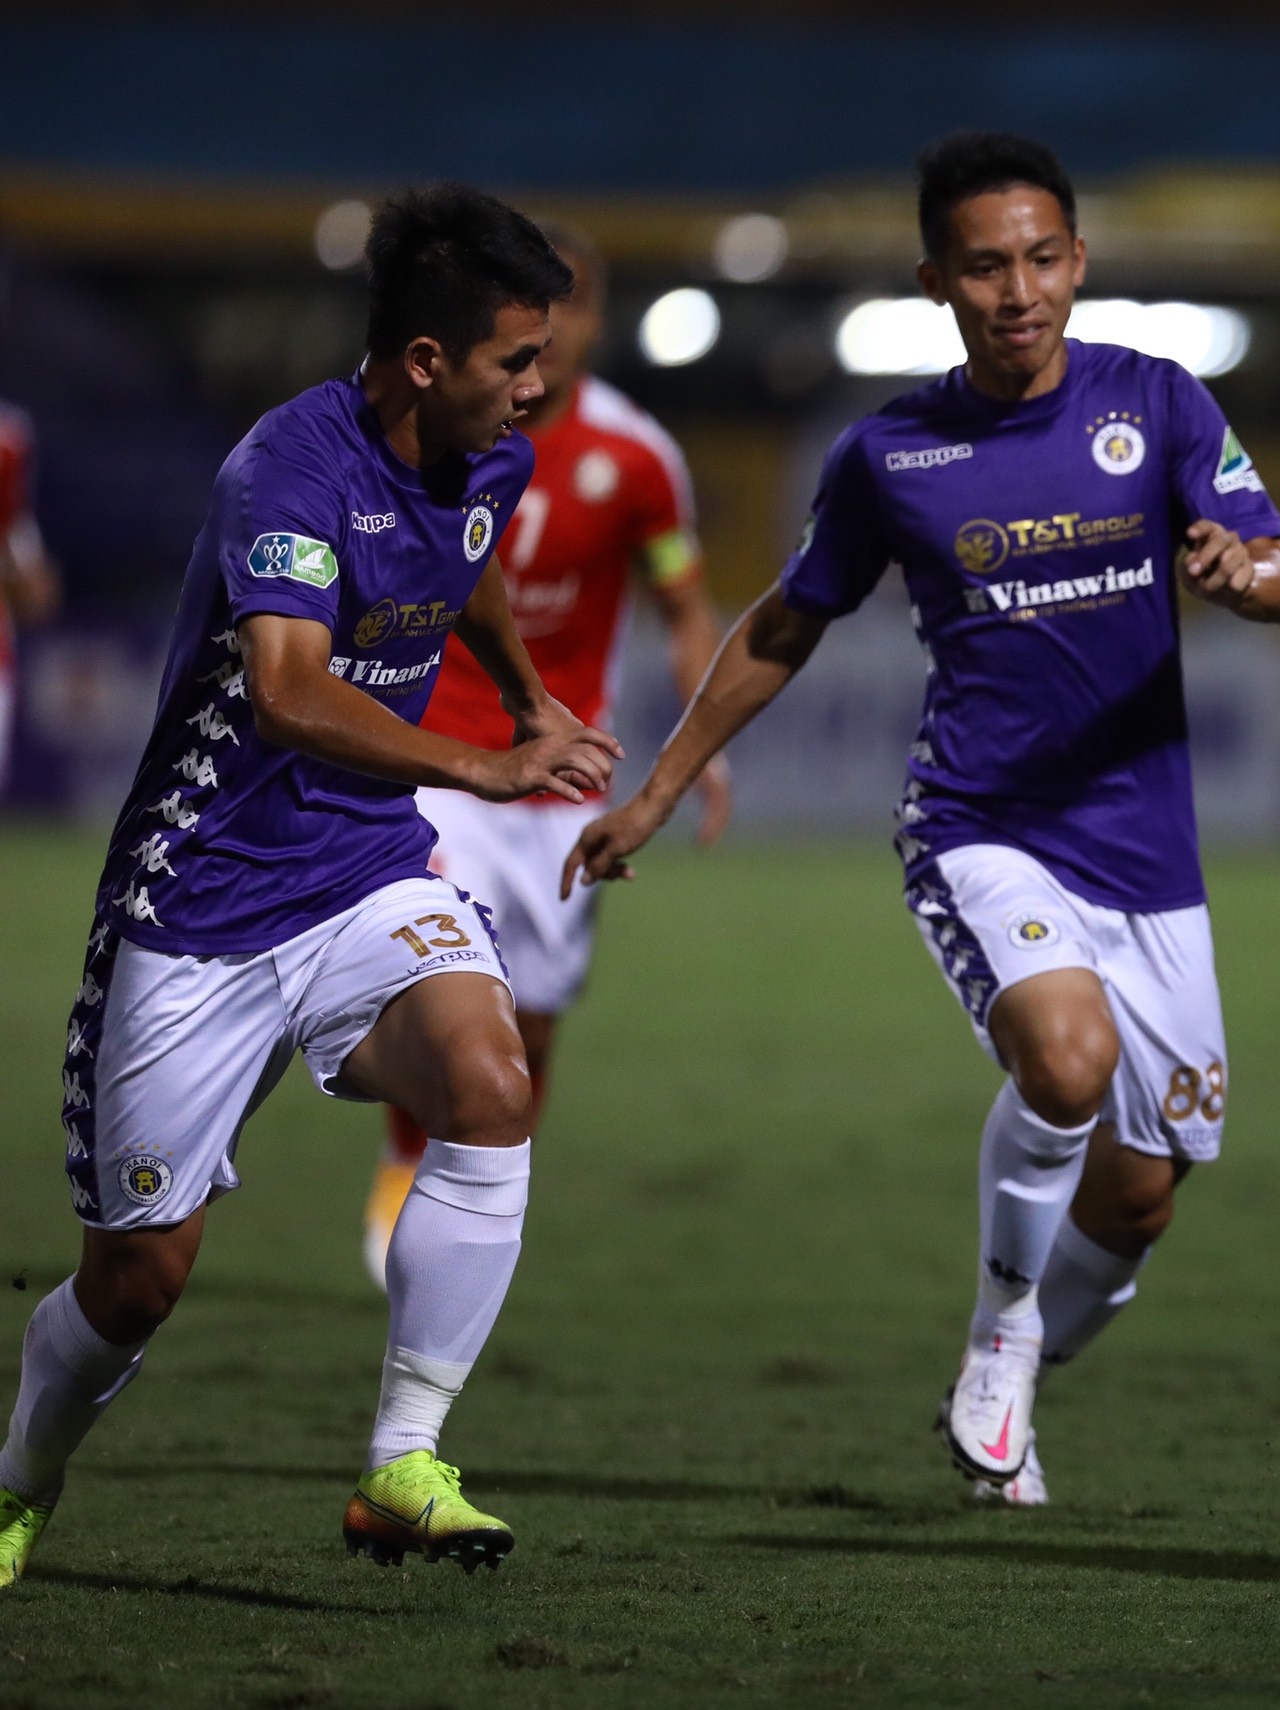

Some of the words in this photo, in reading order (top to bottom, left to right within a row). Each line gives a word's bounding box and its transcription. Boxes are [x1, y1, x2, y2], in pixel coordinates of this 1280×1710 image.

[885, 443, 974, 472] Kappa
[469, 509, 491, 525] HANOI
[1007, 512, 1081, 546] T&T
[1077, 513, 1145, 537] GROUP
[986, 557, 1154, 611] Vinawind
[389, 913, 472, 959] 13
[124, 1157, 162, 1172] HANOI
[127, 1190, 154, 1203] FOOTBALL
[155, 1188, 167, 1200] CLUB
